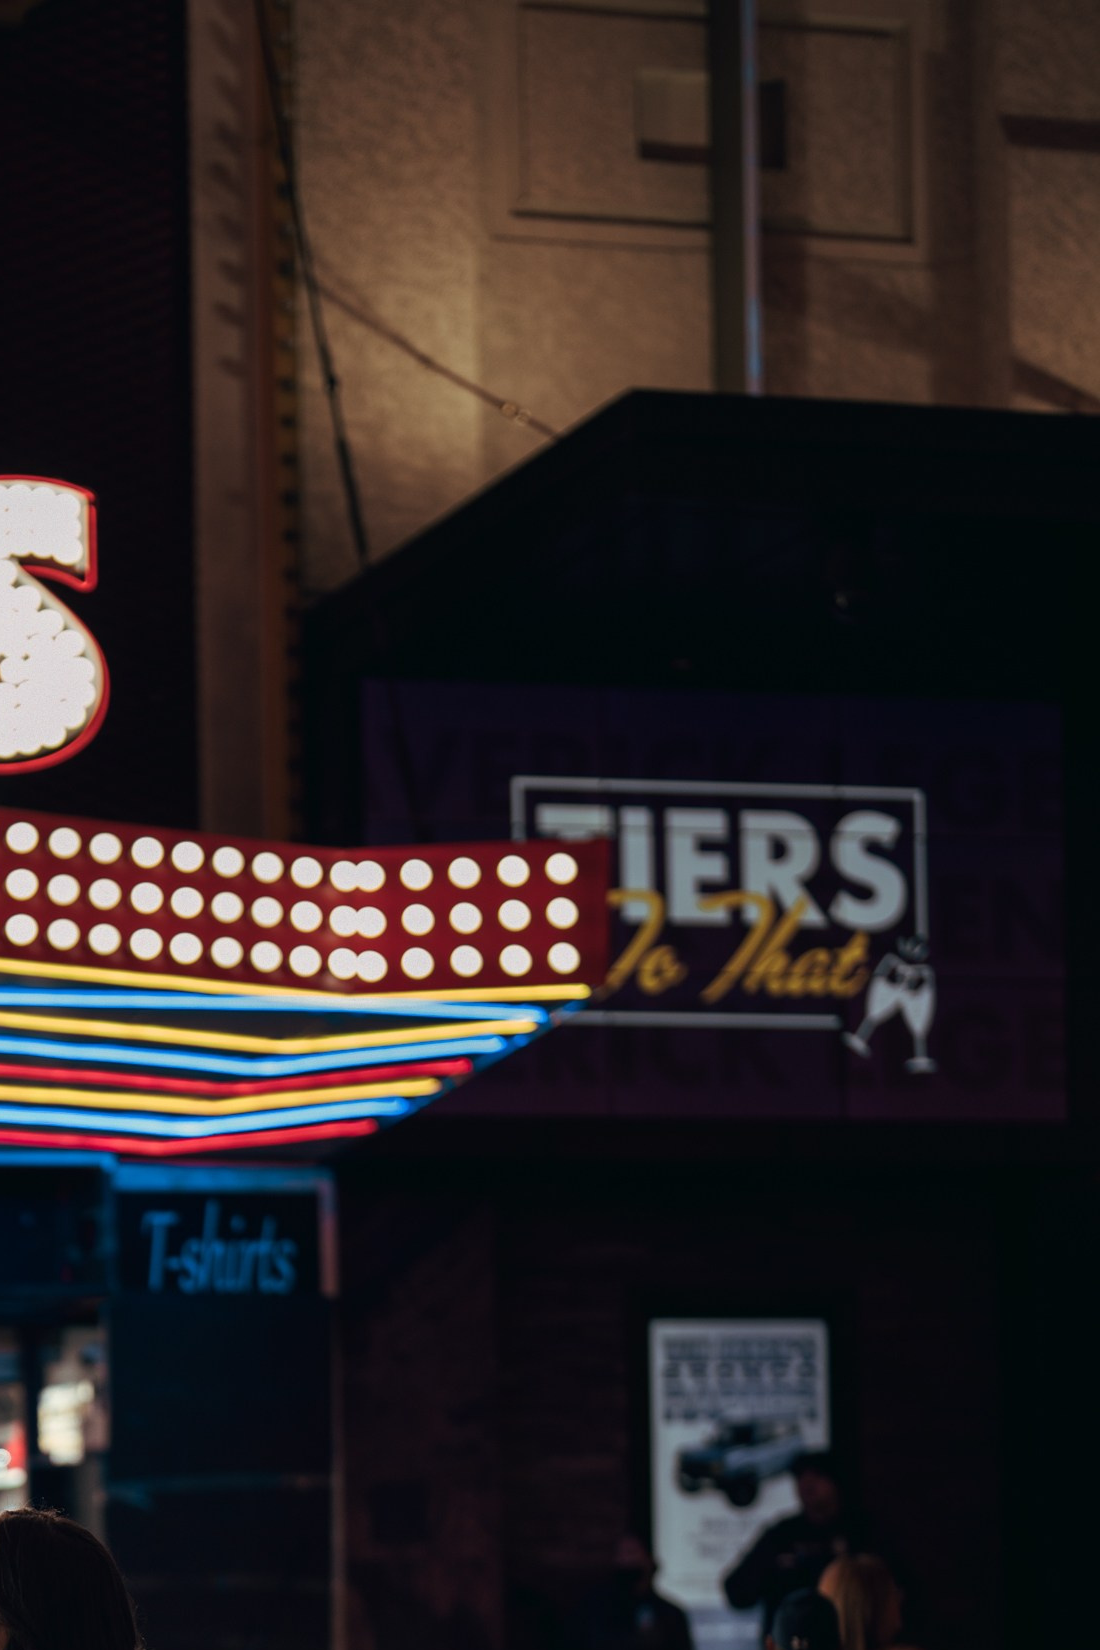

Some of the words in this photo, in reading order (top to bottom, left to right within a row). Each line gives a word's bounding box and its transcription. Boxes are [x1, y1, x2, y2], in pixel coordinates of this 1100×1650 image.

[594, 888, 688, 1001] To
[698, 888, 872, 1004] That
[140, 1198, 299, 1294] T-shirts
